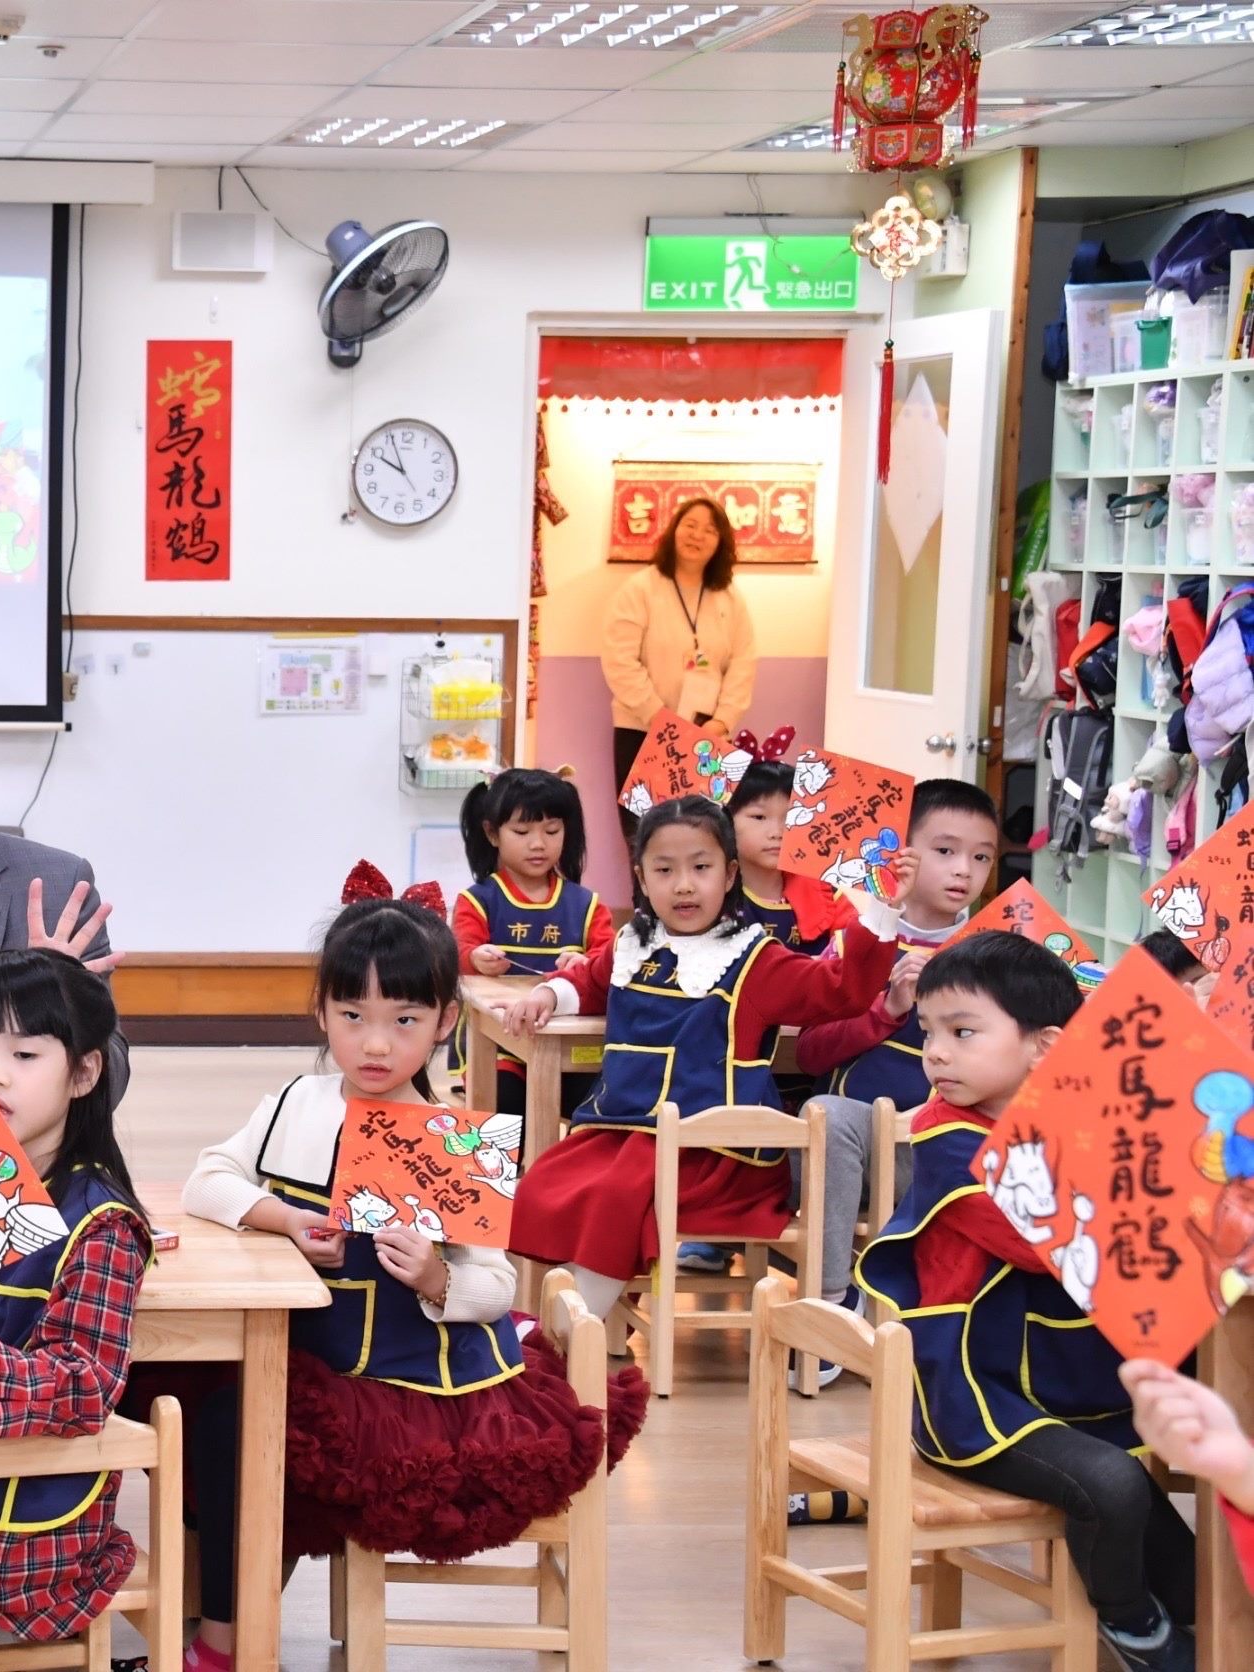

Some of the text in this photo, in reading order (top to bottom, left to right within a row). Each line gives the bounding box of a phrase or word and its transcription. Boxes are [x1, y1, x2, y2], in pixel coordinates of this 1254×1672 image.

[651, 281, 718, 300] EXIT
[775, 280, 853, 300] 緊急出口
[401, 431, 414, 444] 12
[155, 350, 223, 565] 蛇馬龍鶴
[431, 451, 442, 464] 2
[363, 463, 374, 476] 9
[433, 470, 443, 482] 3
[367, 481, 377, 494] 8
[427, 488, 436, 499] 4
[380, 496, 389, 509] 7
[394, 502, 405, 515] 6
[412, 499, 423, 512] 5
[624, 493, 807, 535] 吉如意
[807, 779, 903, 858] 蛇馬龍鶴
[1208, 855, 1231, 865] 2025
[507, 922, 561, 944] 市府
[1053, 1076, 1093, 1091] 2025
[1100, 996, 1183, 1282] 蛇馬龍鶴
[351, 1150, 375, 1166] 2025
[359, 1110, 481, 1215] 蛇馬龍鶴
